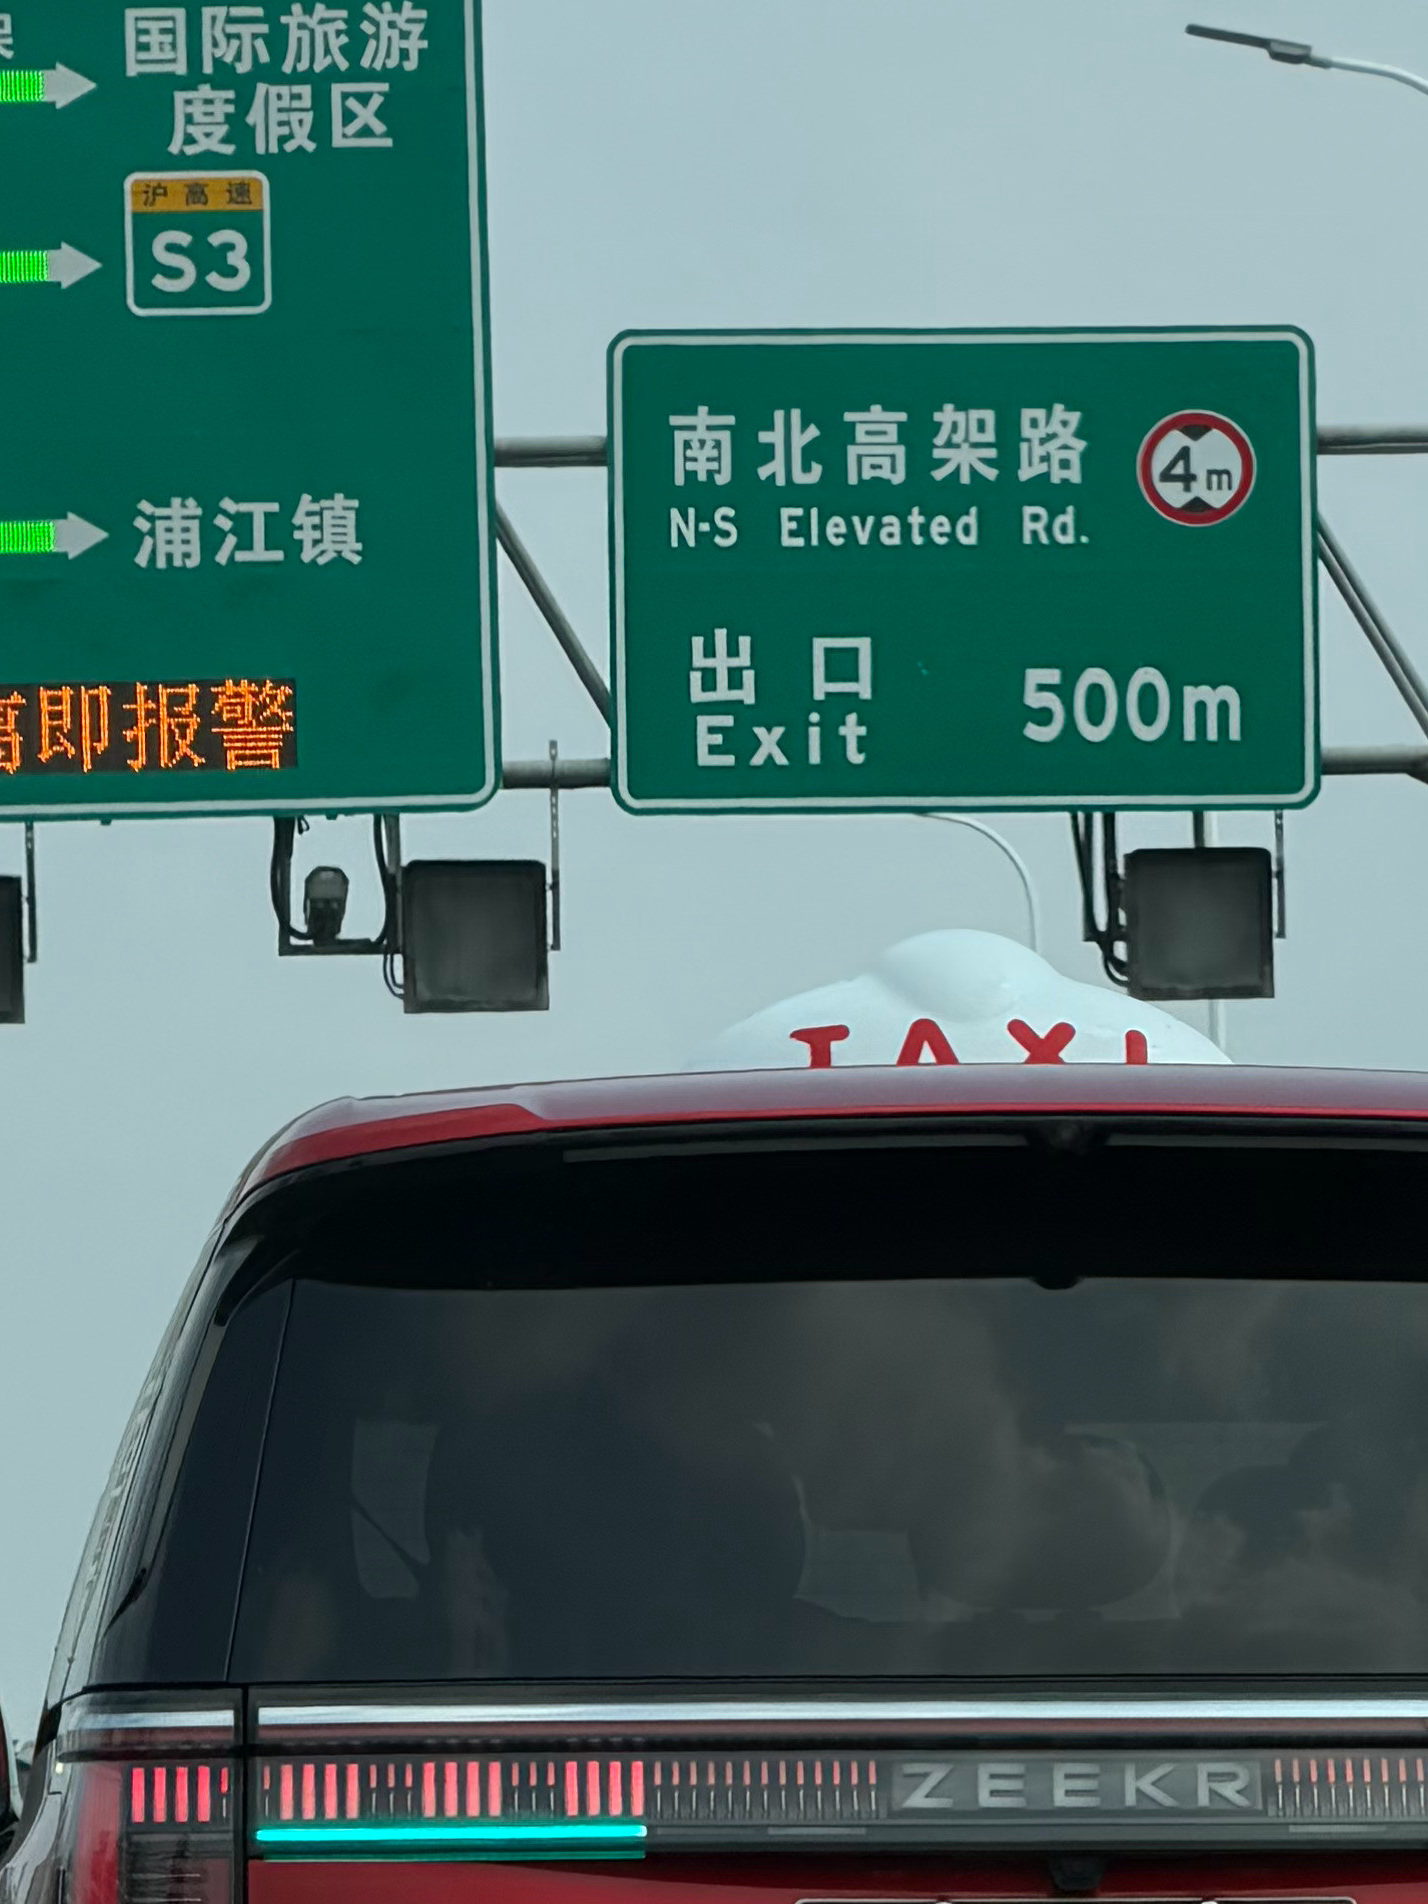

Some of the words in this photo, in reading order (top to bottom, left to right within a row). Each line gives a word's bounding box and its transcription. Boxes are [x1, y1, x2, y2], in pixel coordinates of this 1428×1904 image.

[124, 1, 429, 77] 国际旅游
[168, 81, 394, 156] 度假区
[141, 180, 254, 207] 沪高速
[151, 229, 251, 292] S3
[669, 403, 1087, 487] 南北高架路
[133, 493, 364, 569] 浦江镇
[670, 506, 738, 548] N-S
[780, 506, 978, 547] Elevated
[1022, 505, 1090, 545] Rd.
[689, 628, 872, 705] 出口
[696, 711, 867, 766] Exit
[1023, 666, 1241, 743] 500m
[901, 1762, 1252, 1808] ZEEKR
